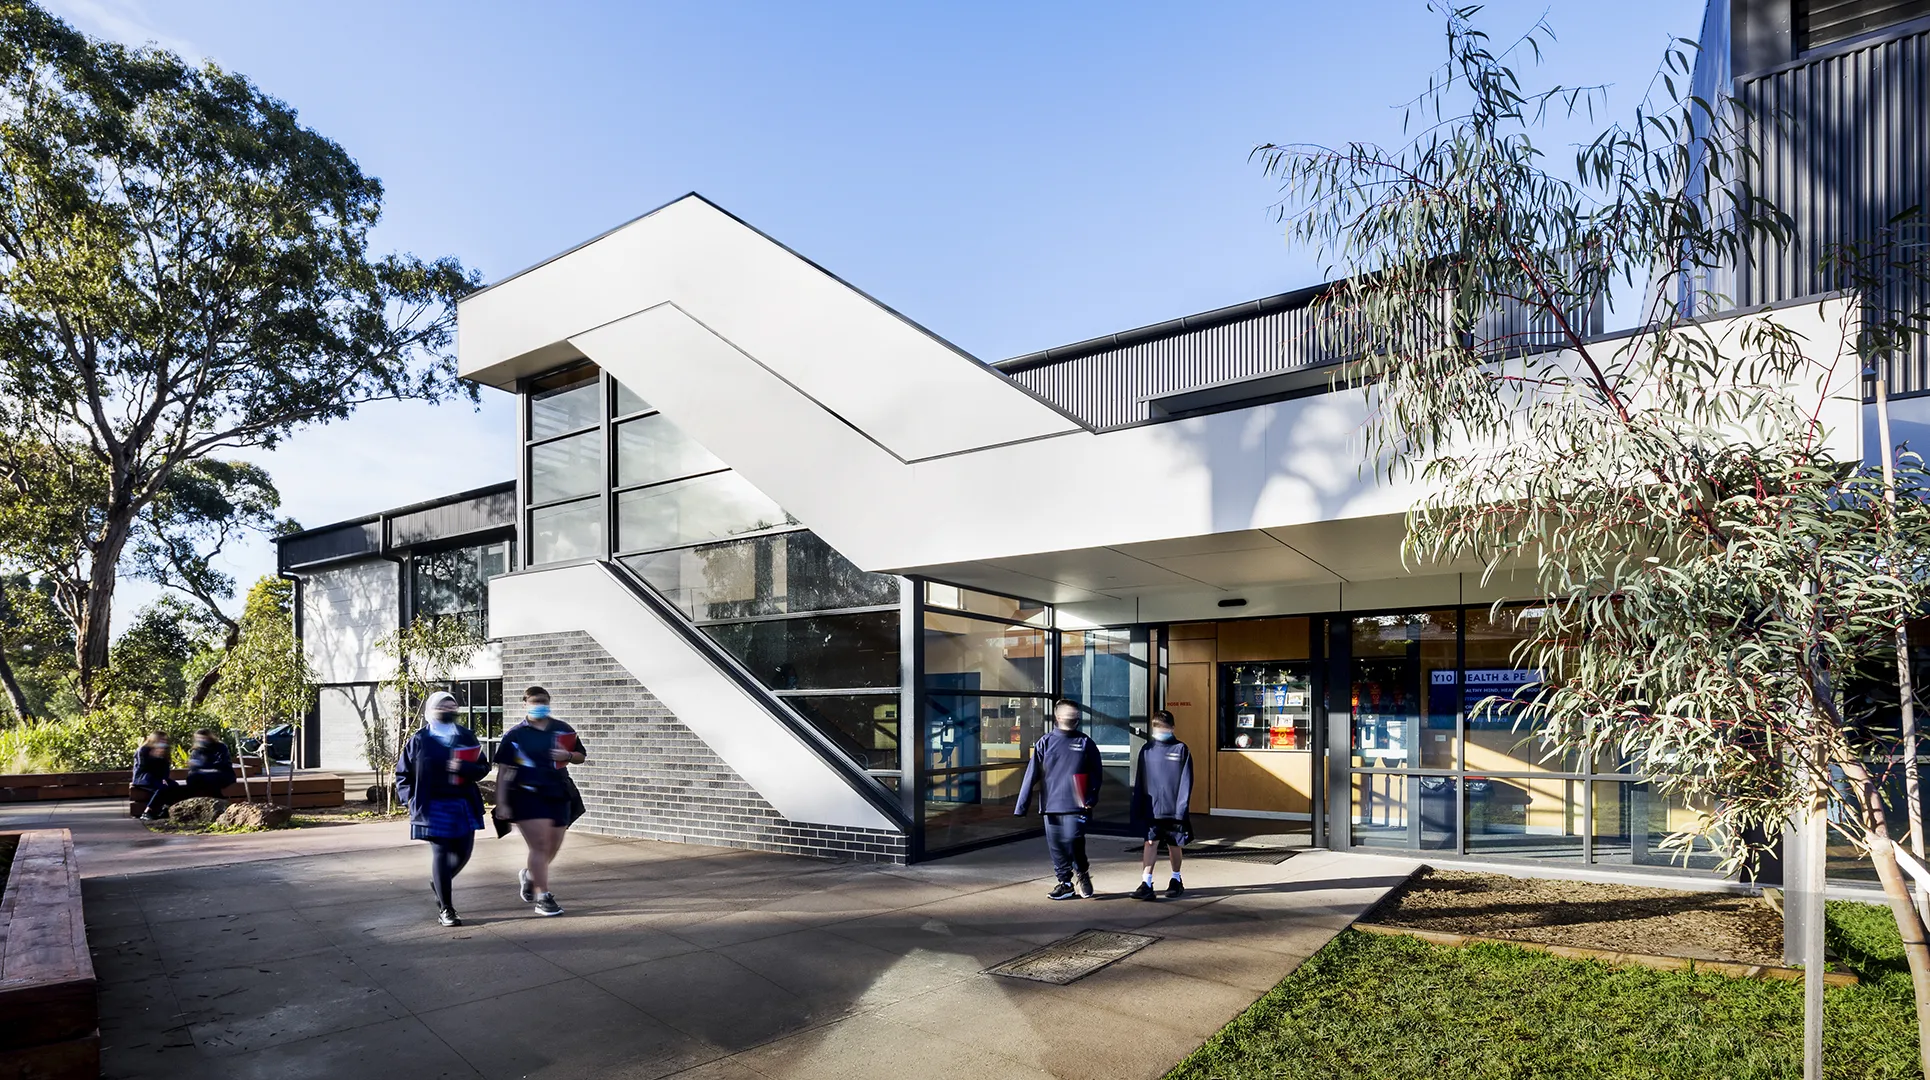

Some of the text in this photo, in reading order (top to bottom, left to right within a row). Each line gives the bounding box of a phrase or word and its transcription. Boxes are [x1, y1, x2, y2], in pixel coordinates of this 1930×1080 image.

[1434, 674, 1452, 682] Y10
[1502, 673, 1510, 682] &
[1513, 673, 1526, 681] PE
